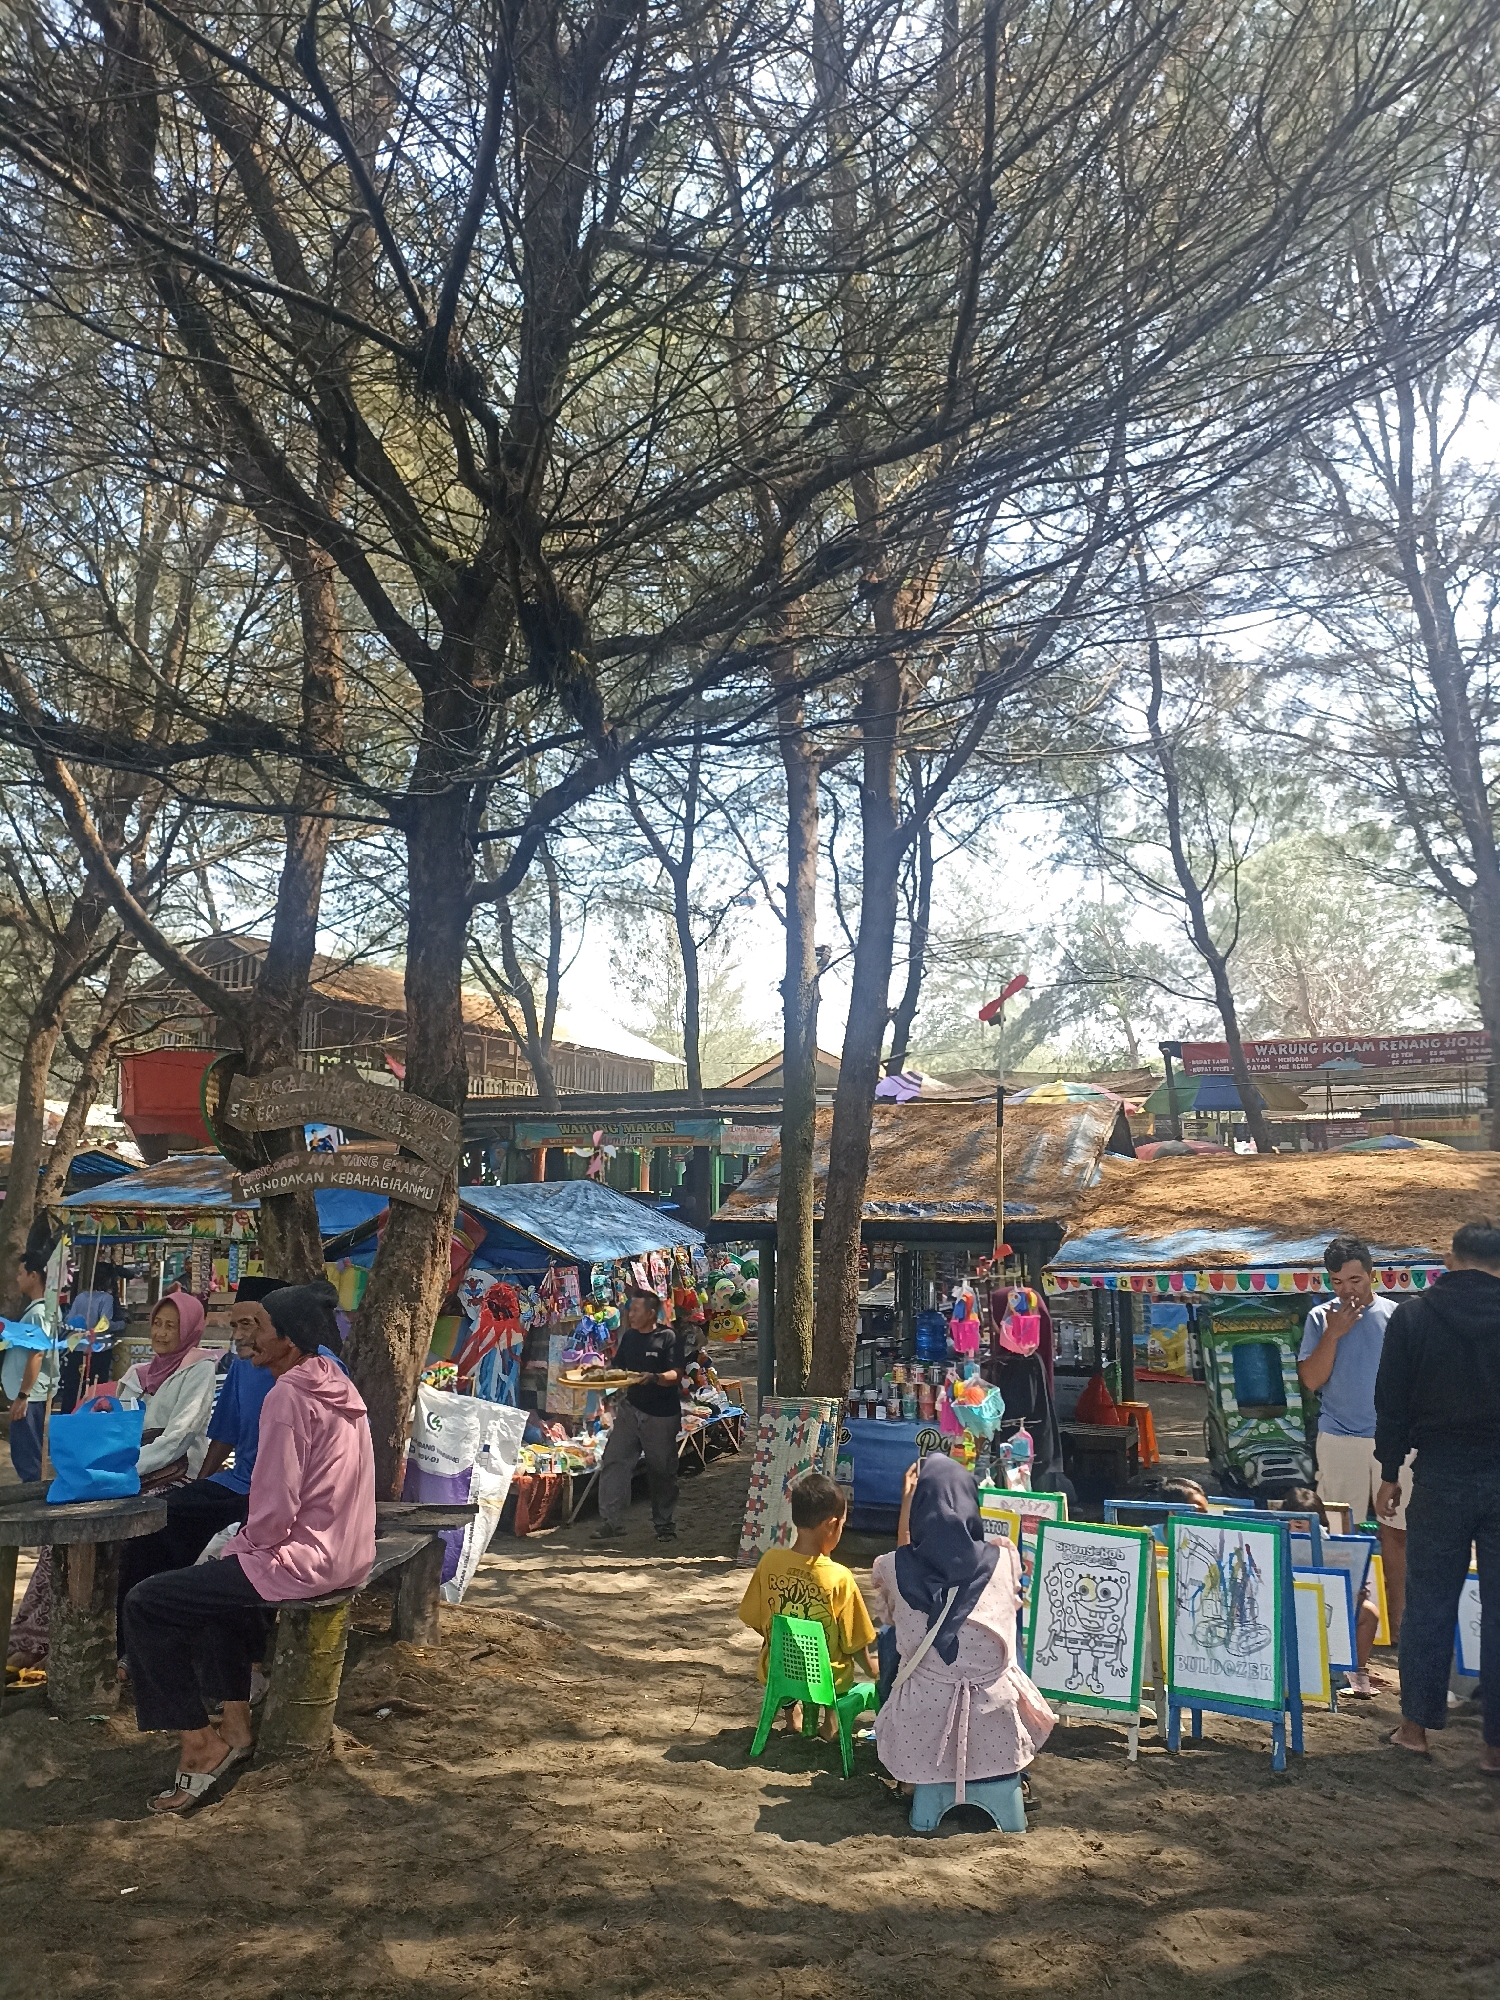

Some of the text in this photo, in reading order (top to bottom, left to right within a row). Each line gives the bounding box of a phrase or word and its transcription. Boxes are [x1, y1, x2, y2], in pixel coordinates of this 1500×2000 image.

[1254, 1036, 1485, 1056] WARUNG KOLAM RENANG HOKI
[621, 1121, 675, 1133] MAKAN
[341, 1154, 379, 1168] YANG
[242, 1171, 435, 1200] MENDOAKAN KEBAHAGIAANMU
[1174, 1654, 1273, 1681] BULDOZER
